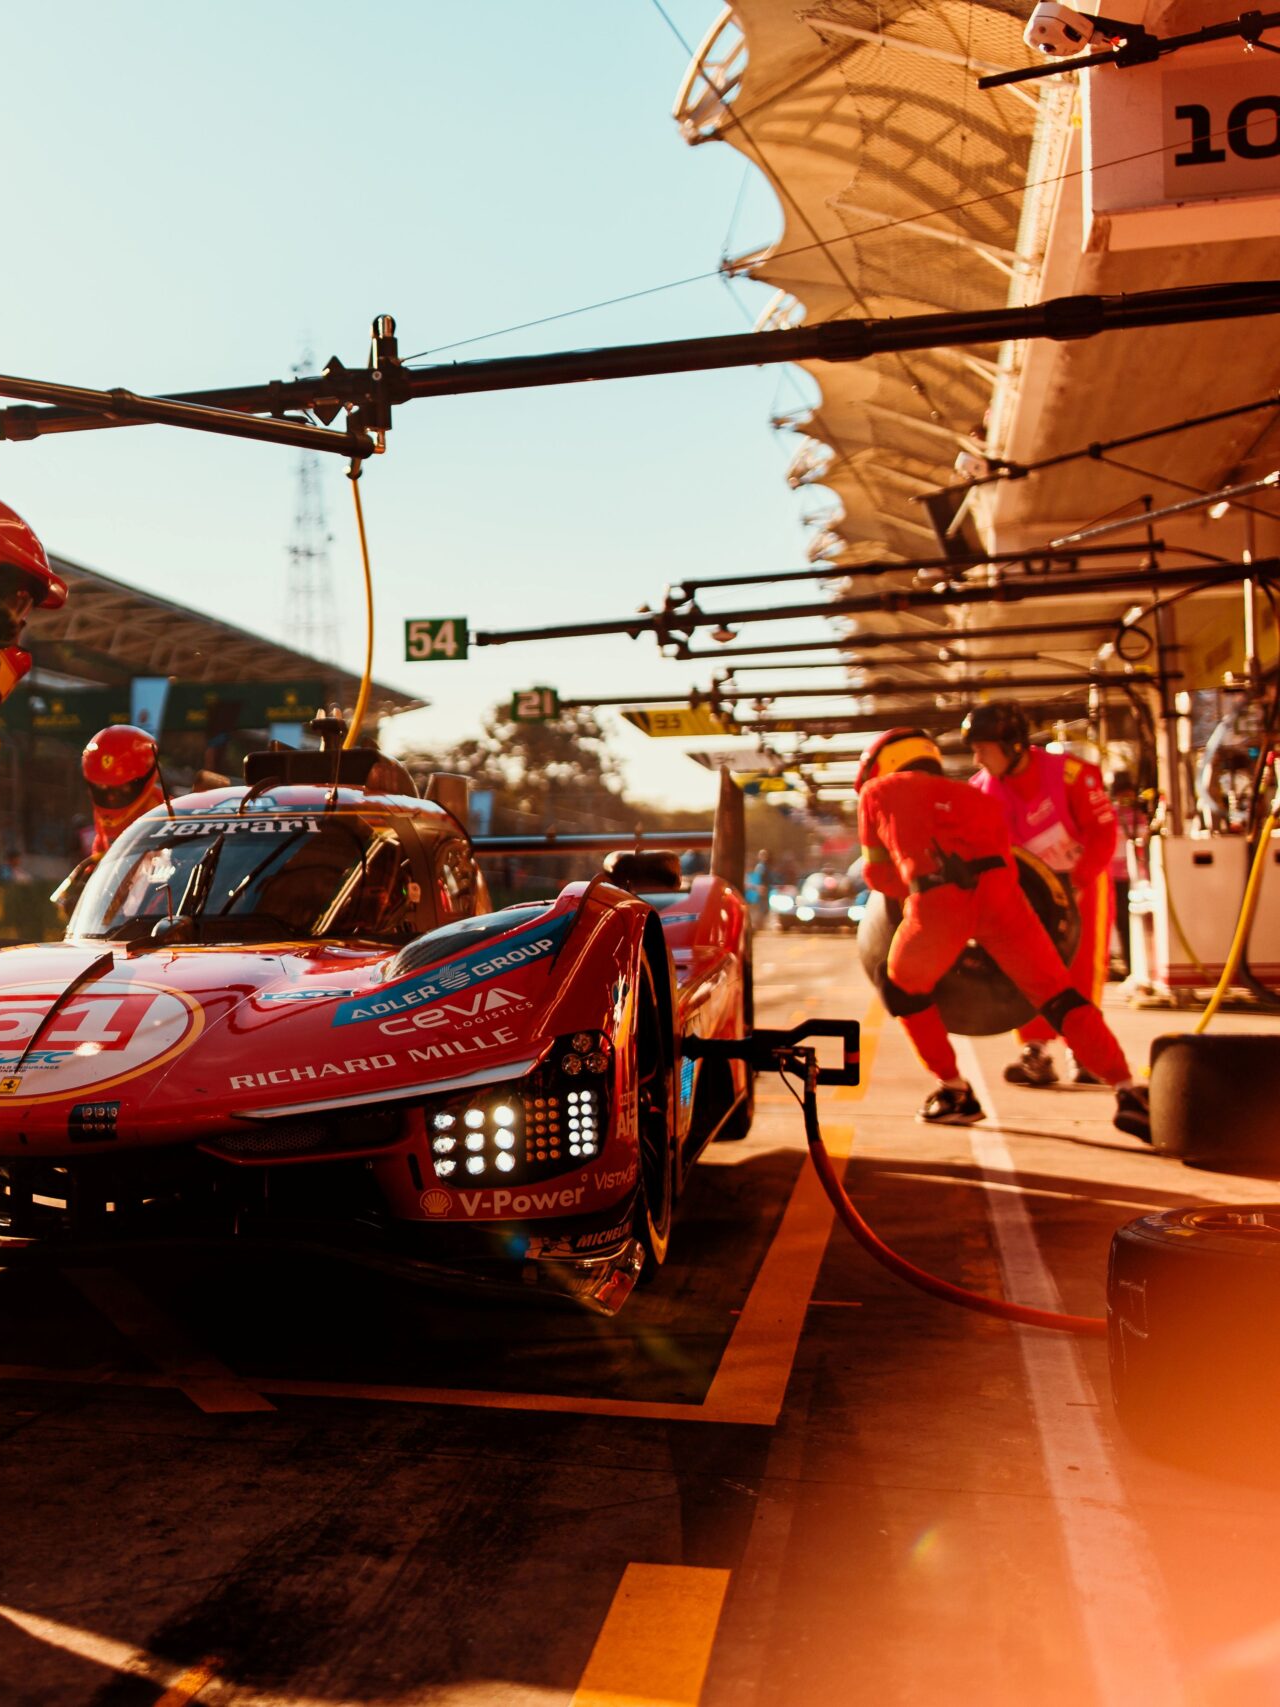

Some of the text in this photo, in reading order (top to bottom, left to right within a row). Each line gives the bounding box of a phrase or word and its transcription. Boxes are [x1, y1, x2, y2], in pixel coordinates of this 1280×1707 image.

[1175, 95, 1280, 167] 10
[408, 620, 458, 658] 54
[517, 690, 554, 718] 21
[149, 816, 322, 838] Ferrari
[350, 938, 554, 1020] ADLER GROUP
[454, 1002, 534, 1031] LOGISTICS
[229, 1026, 519, 1090] RICHARD MILLE
[458, 1186, 586, 1217] V-Power
